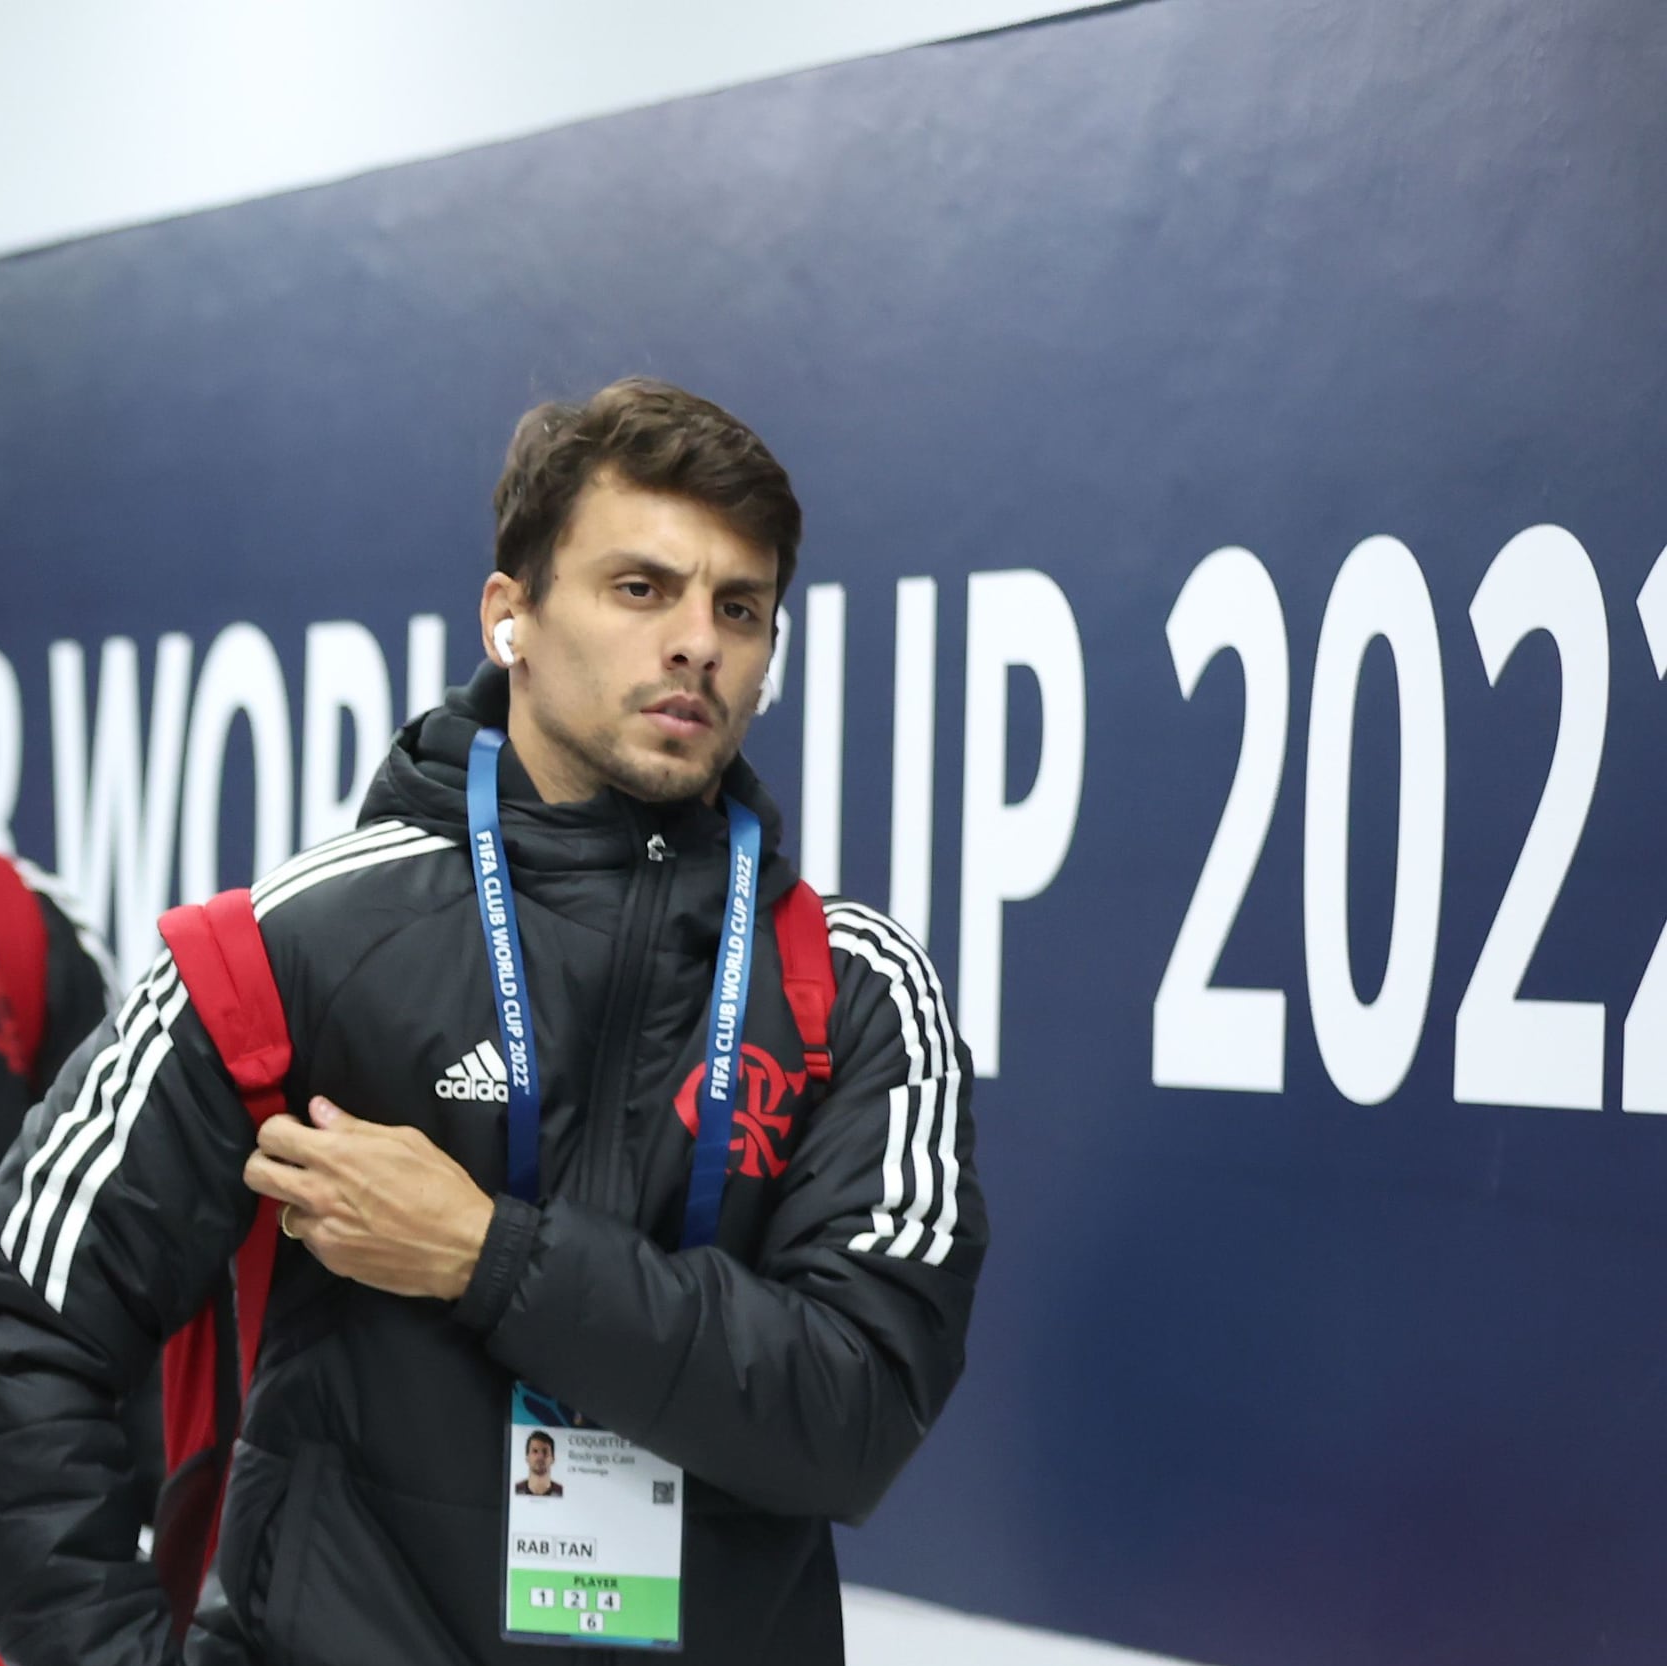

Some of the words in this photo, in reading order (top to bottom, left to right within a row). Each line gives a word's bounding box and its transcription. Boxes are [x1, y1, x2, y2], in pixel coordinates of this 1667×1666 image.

[767, 568, 1087, 1079] UP
[476, 830, 497, 876] FIFA
[484, 877, 506, 926] CLUB
[730, 900, 748, 936] CUP
[492, 926, 517, 999] WORLD
[721, 935, 746, 1002] WORLD
[503, 999, 524, 1039] CUP
[716, 1002, 737, 1052] CLUB
[435, 1077, 509, 1104] adida
[710, 1055, 731, 1101] FIFA
[517, 1539, 550, 1555] RAB
[559, 1542, 593, 1558] TAN
[570, 1593, 580, 1607] 2
[604, 1595, 614, 1608] 4
[574, 1576, 619, 1588] PLAYER
[587, 1615, 596, 1630] 6
